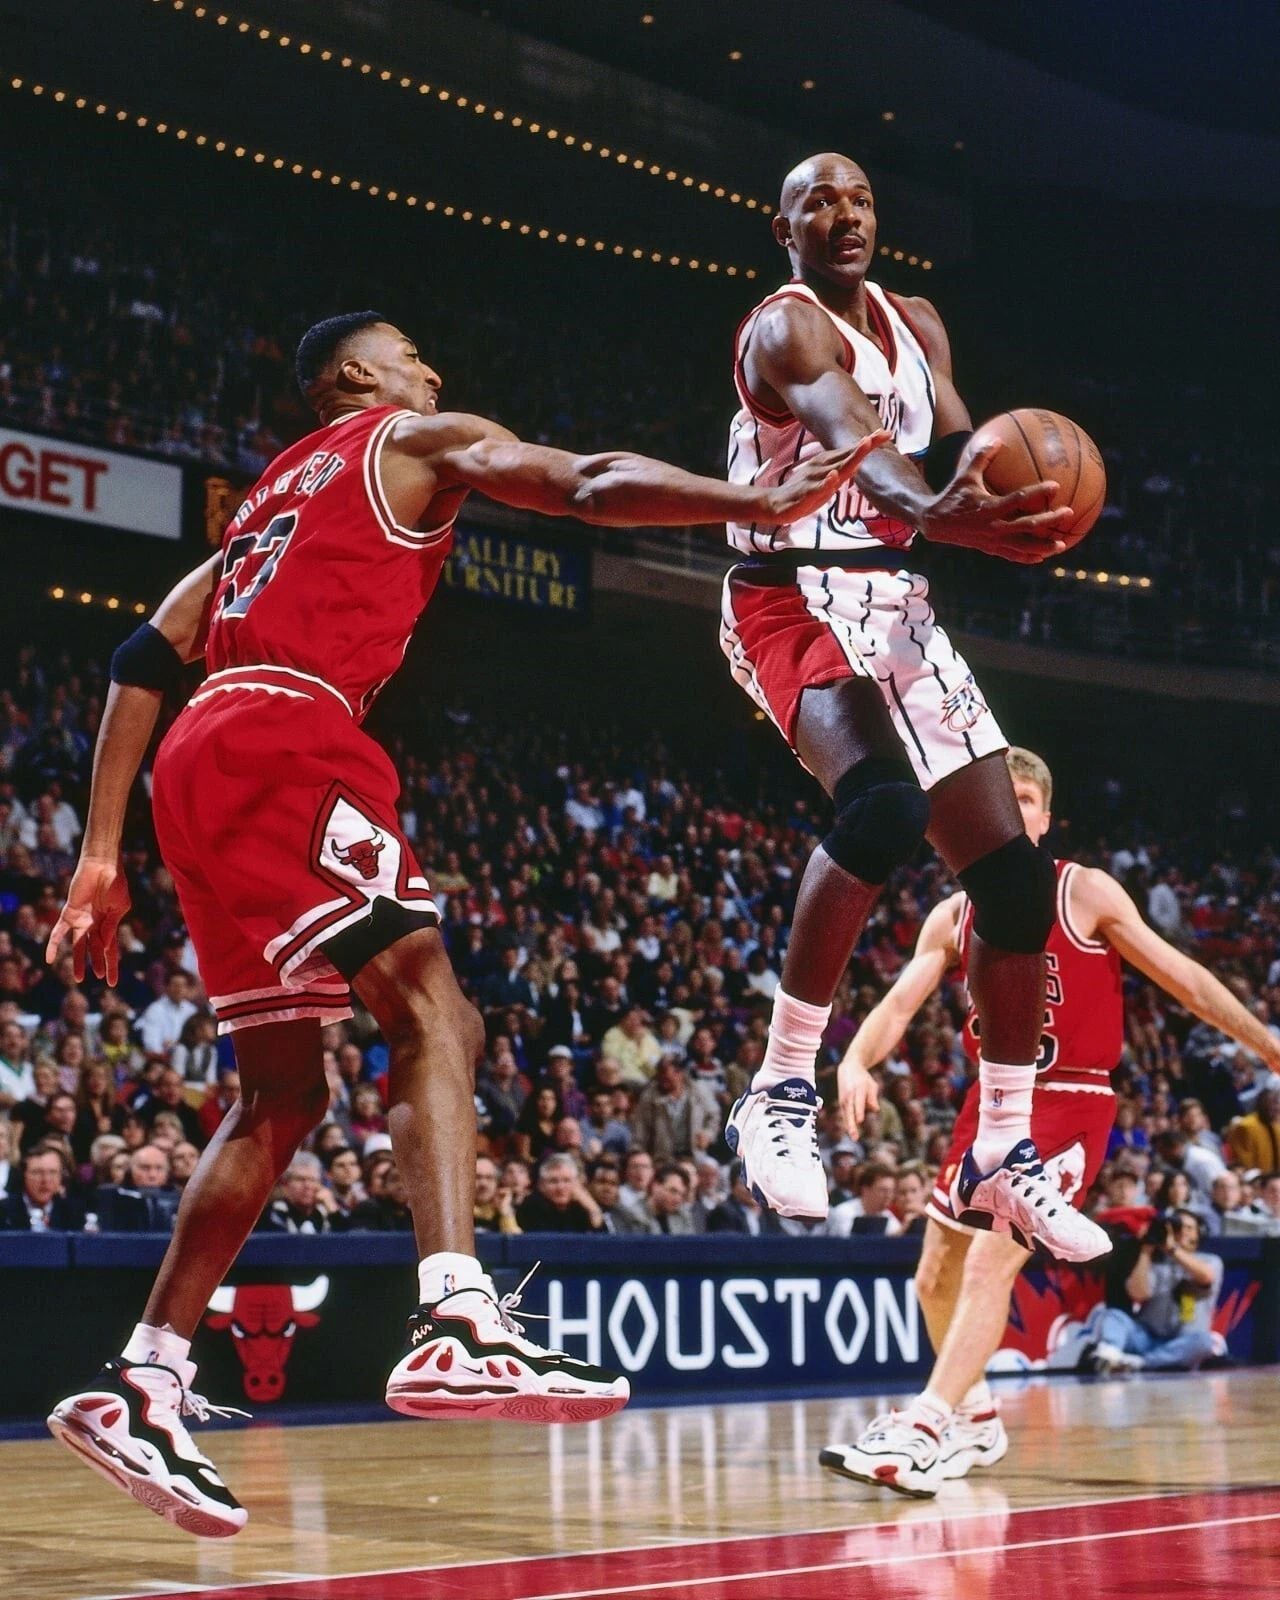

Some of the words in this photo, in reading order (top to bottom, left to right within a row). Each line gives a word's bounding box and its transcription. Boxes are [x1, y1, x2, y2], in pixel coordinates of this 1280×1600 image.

[0, 442, 108, 511] GET
[455, 535, 561, 579] ALLERY
[443, 560, 577, 609] URNITURE
[411, 1323, 433, 1346] Air
[548, 1277, 920, 1372] HOUSTON
